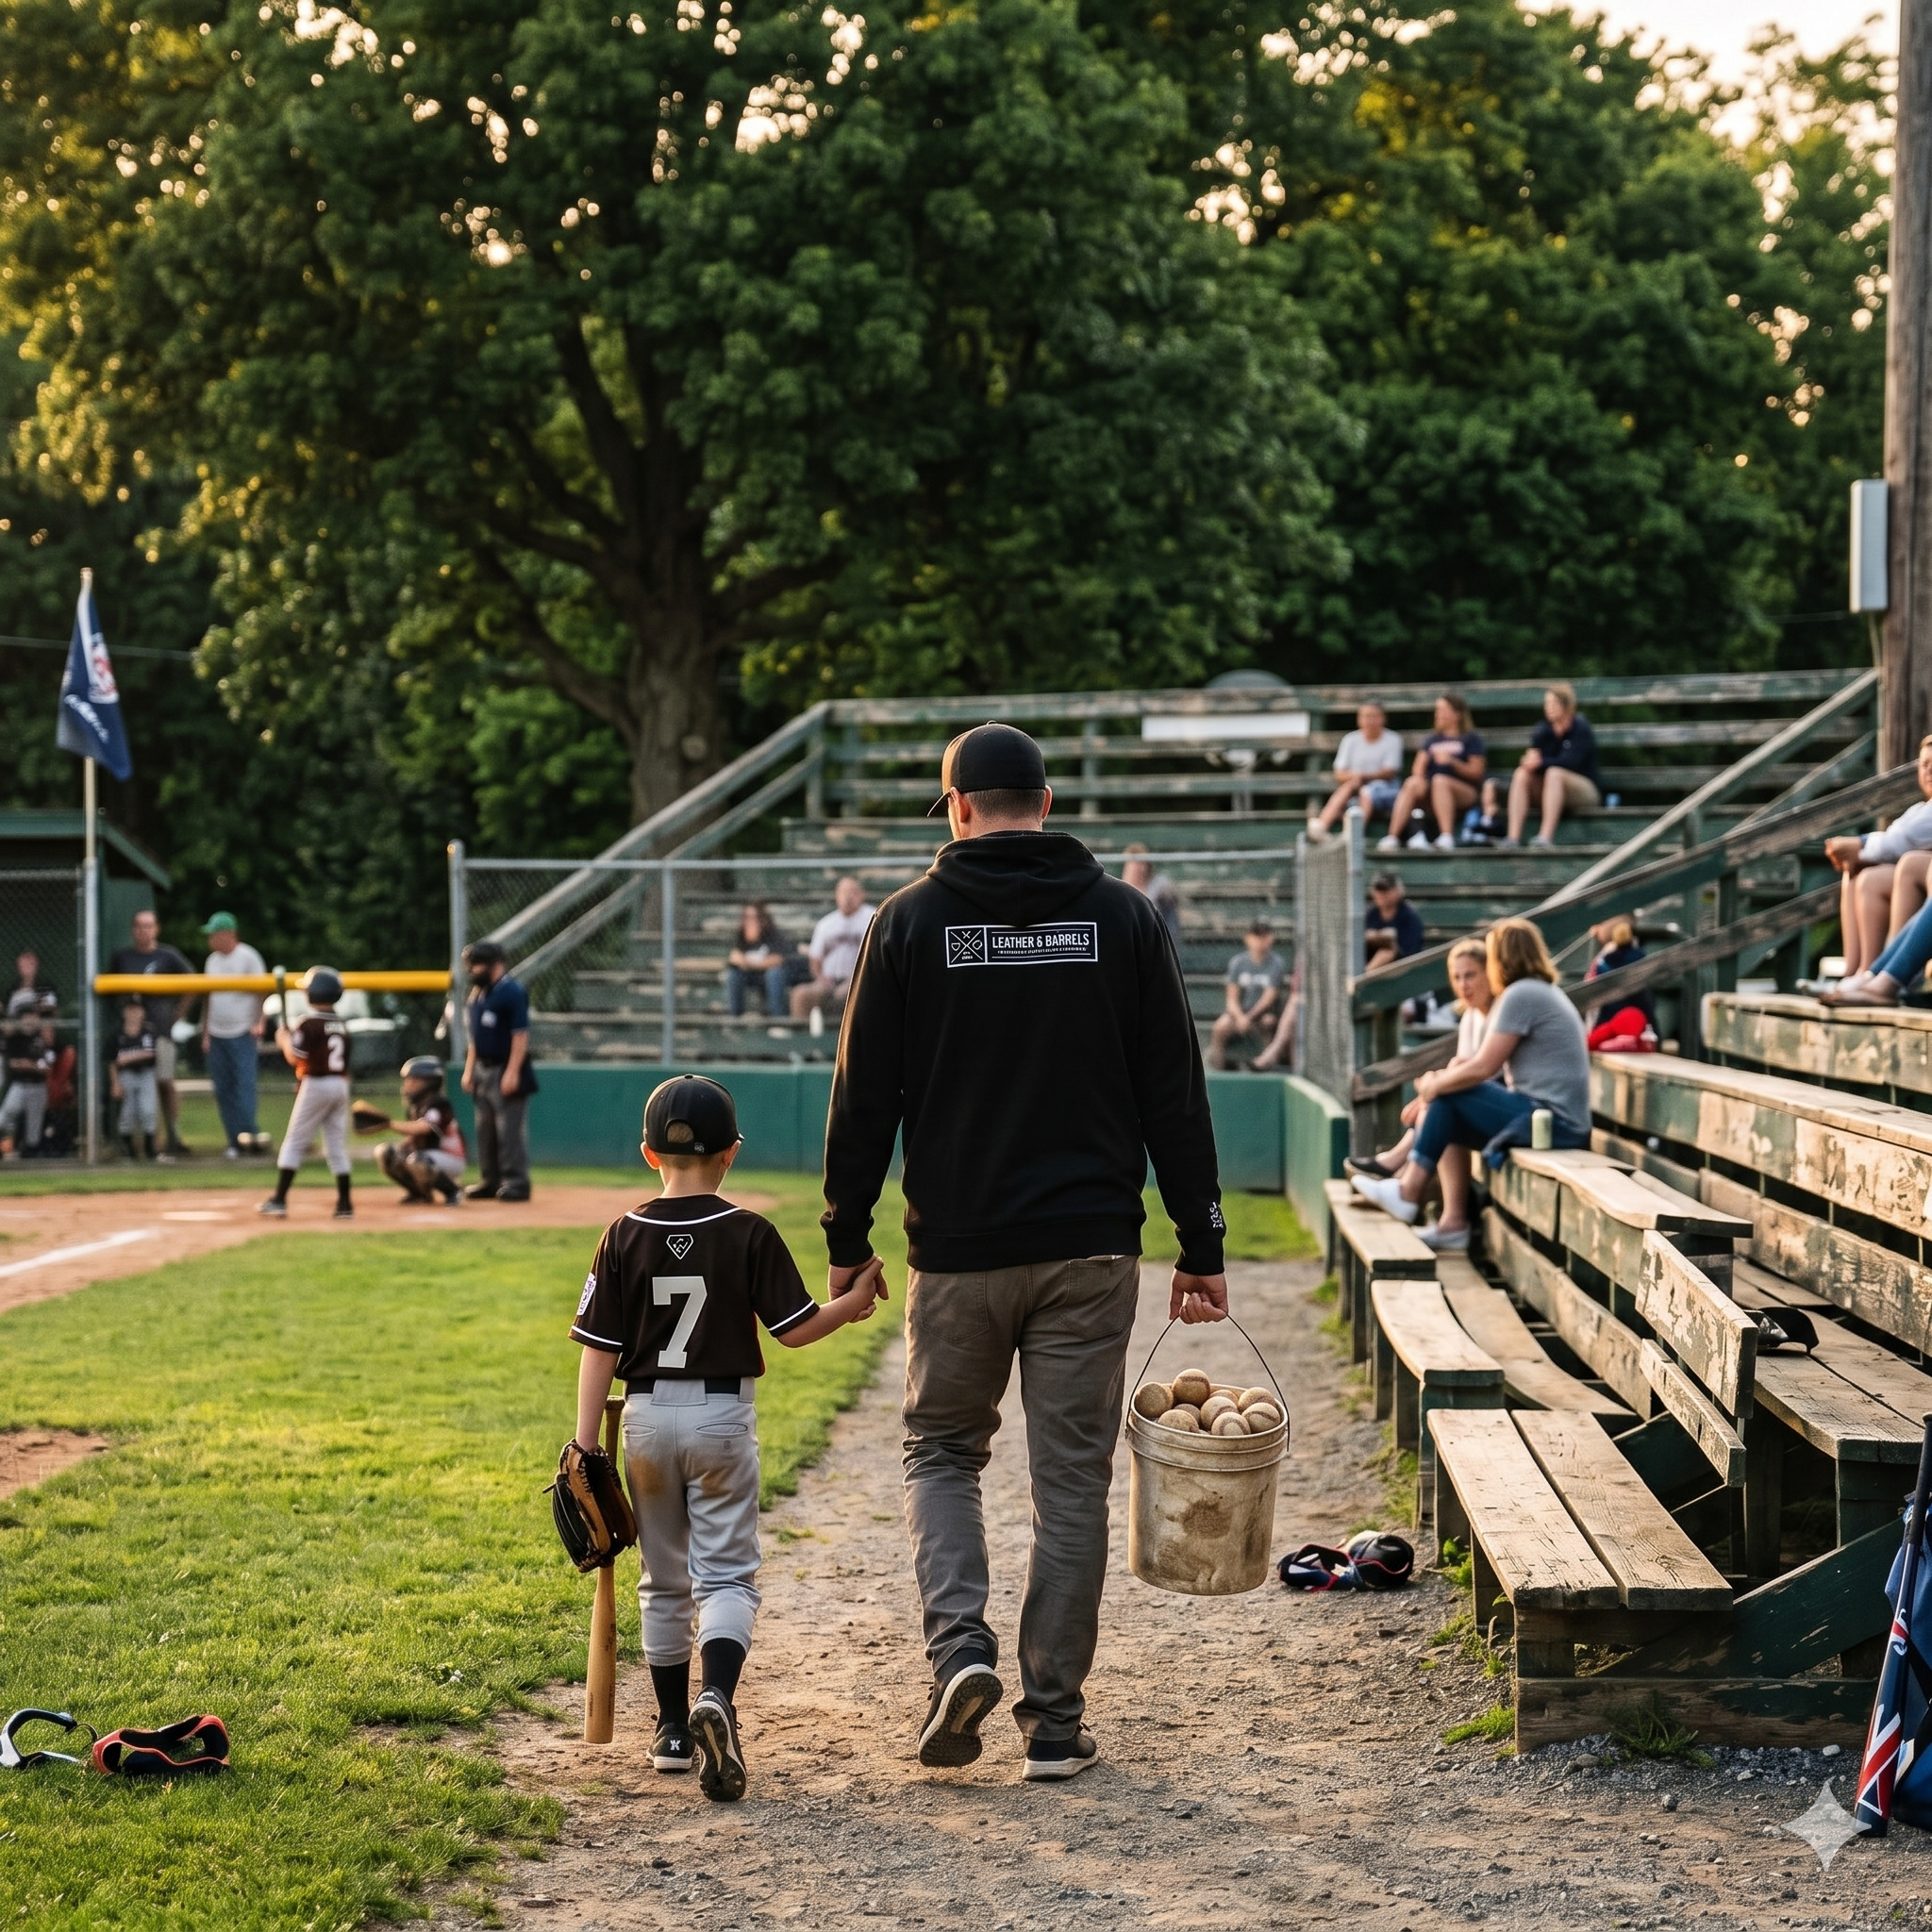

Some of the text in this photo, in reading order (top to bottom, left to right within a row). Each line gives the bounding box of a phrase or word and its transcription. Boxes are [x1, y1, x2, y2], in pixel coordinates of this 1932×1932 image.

[992, 933, 1090, 949] LEATHER & BARRELS
[327, 1034, 345, 1072] 2
[652, 1275, 708, 1369] 7
